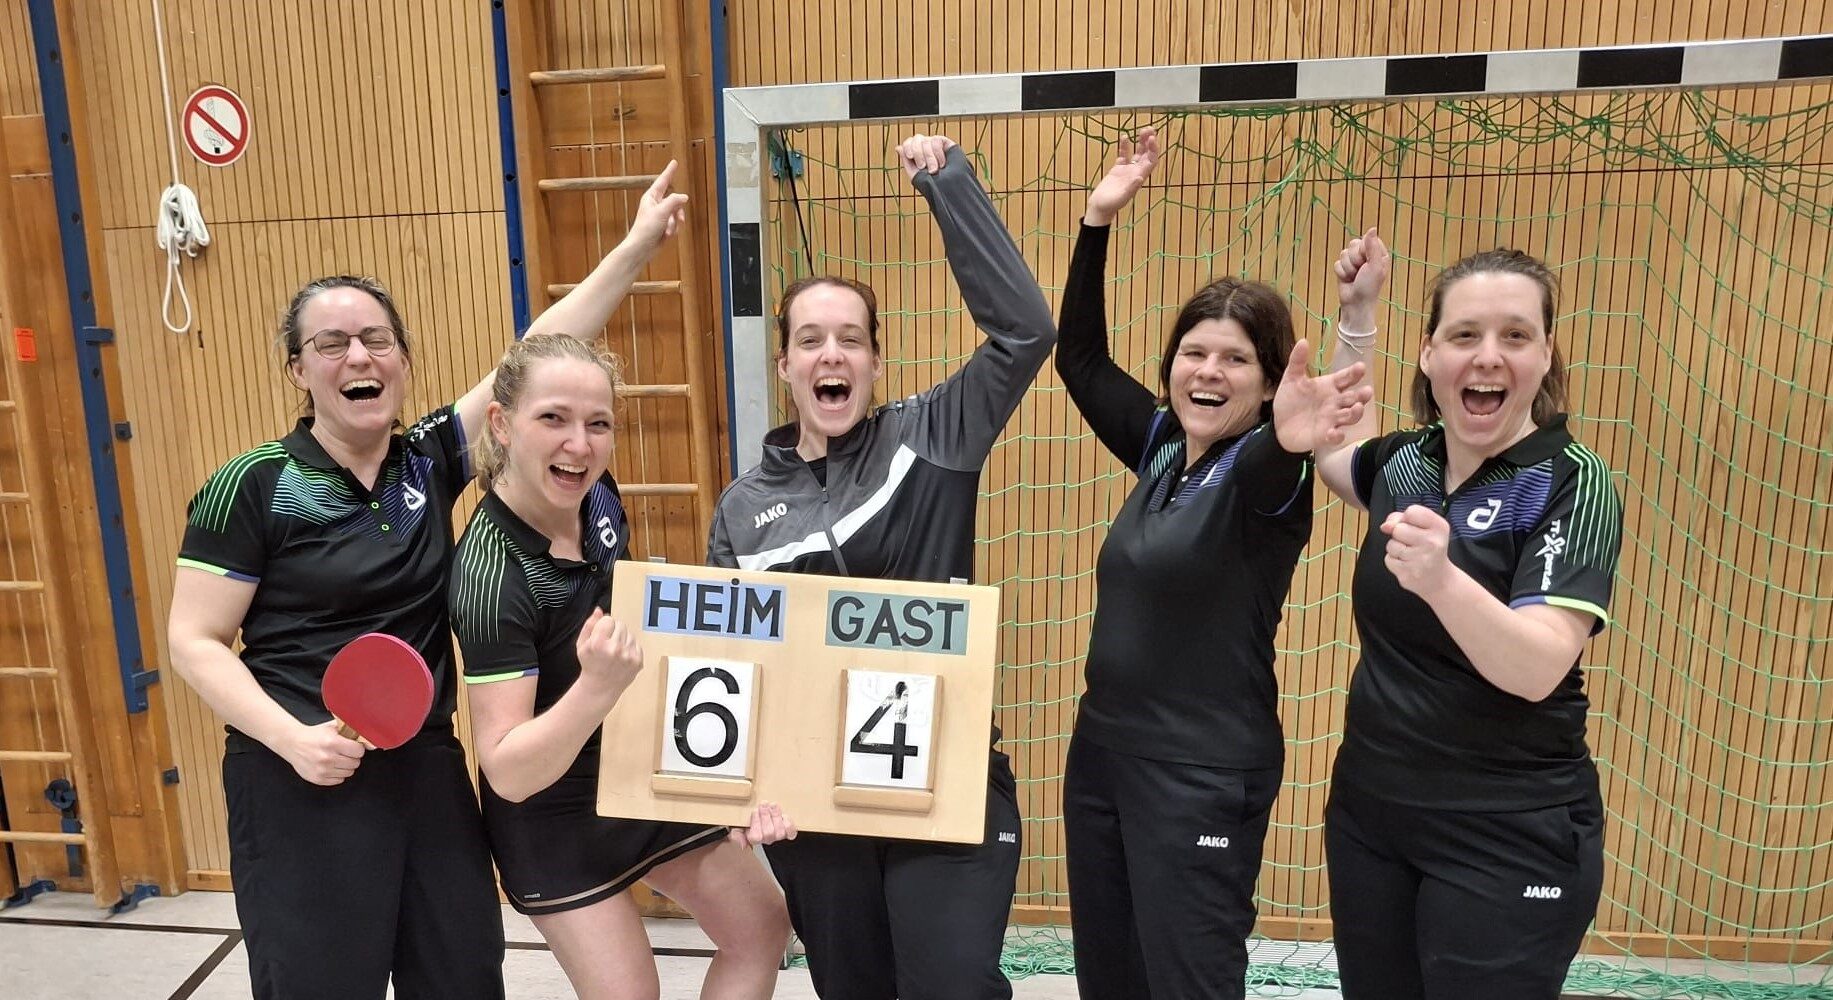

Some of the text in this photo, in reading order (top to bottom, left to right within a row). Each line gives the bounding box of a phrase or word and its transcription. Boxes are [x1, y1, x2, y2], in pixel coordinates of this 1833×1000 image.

[754, 502, 788, 529] JAKO
[830, 595, 965, 650] GAST
[673, 667, 740, 767] 6
[849, 681, 919, 780] 4
[1196, 835, 1229, 848] JAKO
[1523, 885, 1562, 899] JAKO
